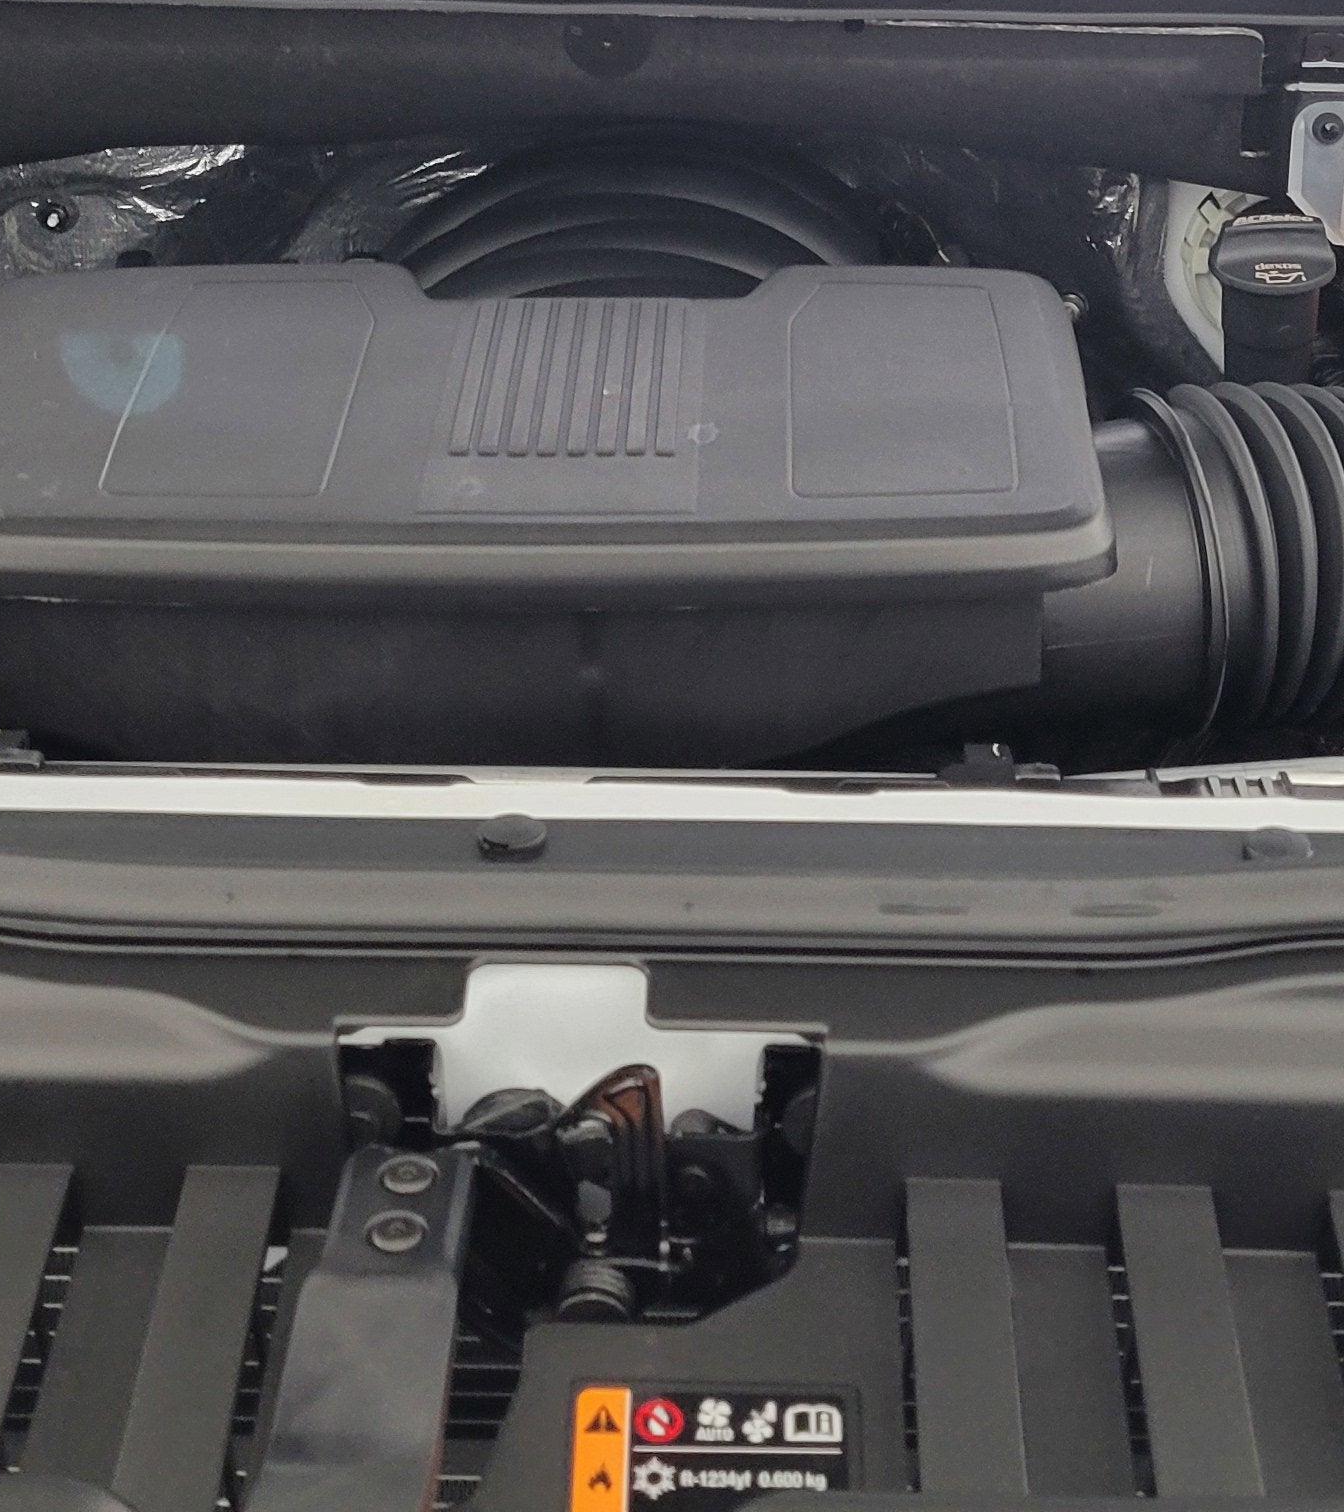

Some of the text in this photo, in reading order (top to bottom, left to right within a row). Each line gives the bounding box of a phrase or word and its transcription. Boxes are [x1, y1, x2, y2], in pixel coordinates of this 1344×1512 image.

[1232, 214, 1314, 226] ACDelco
[695, 1426, 735, 1441] AUTO
[679, 1468, 753, 1491] R-1234yf
[805, 1471, 828, 1492] kg
